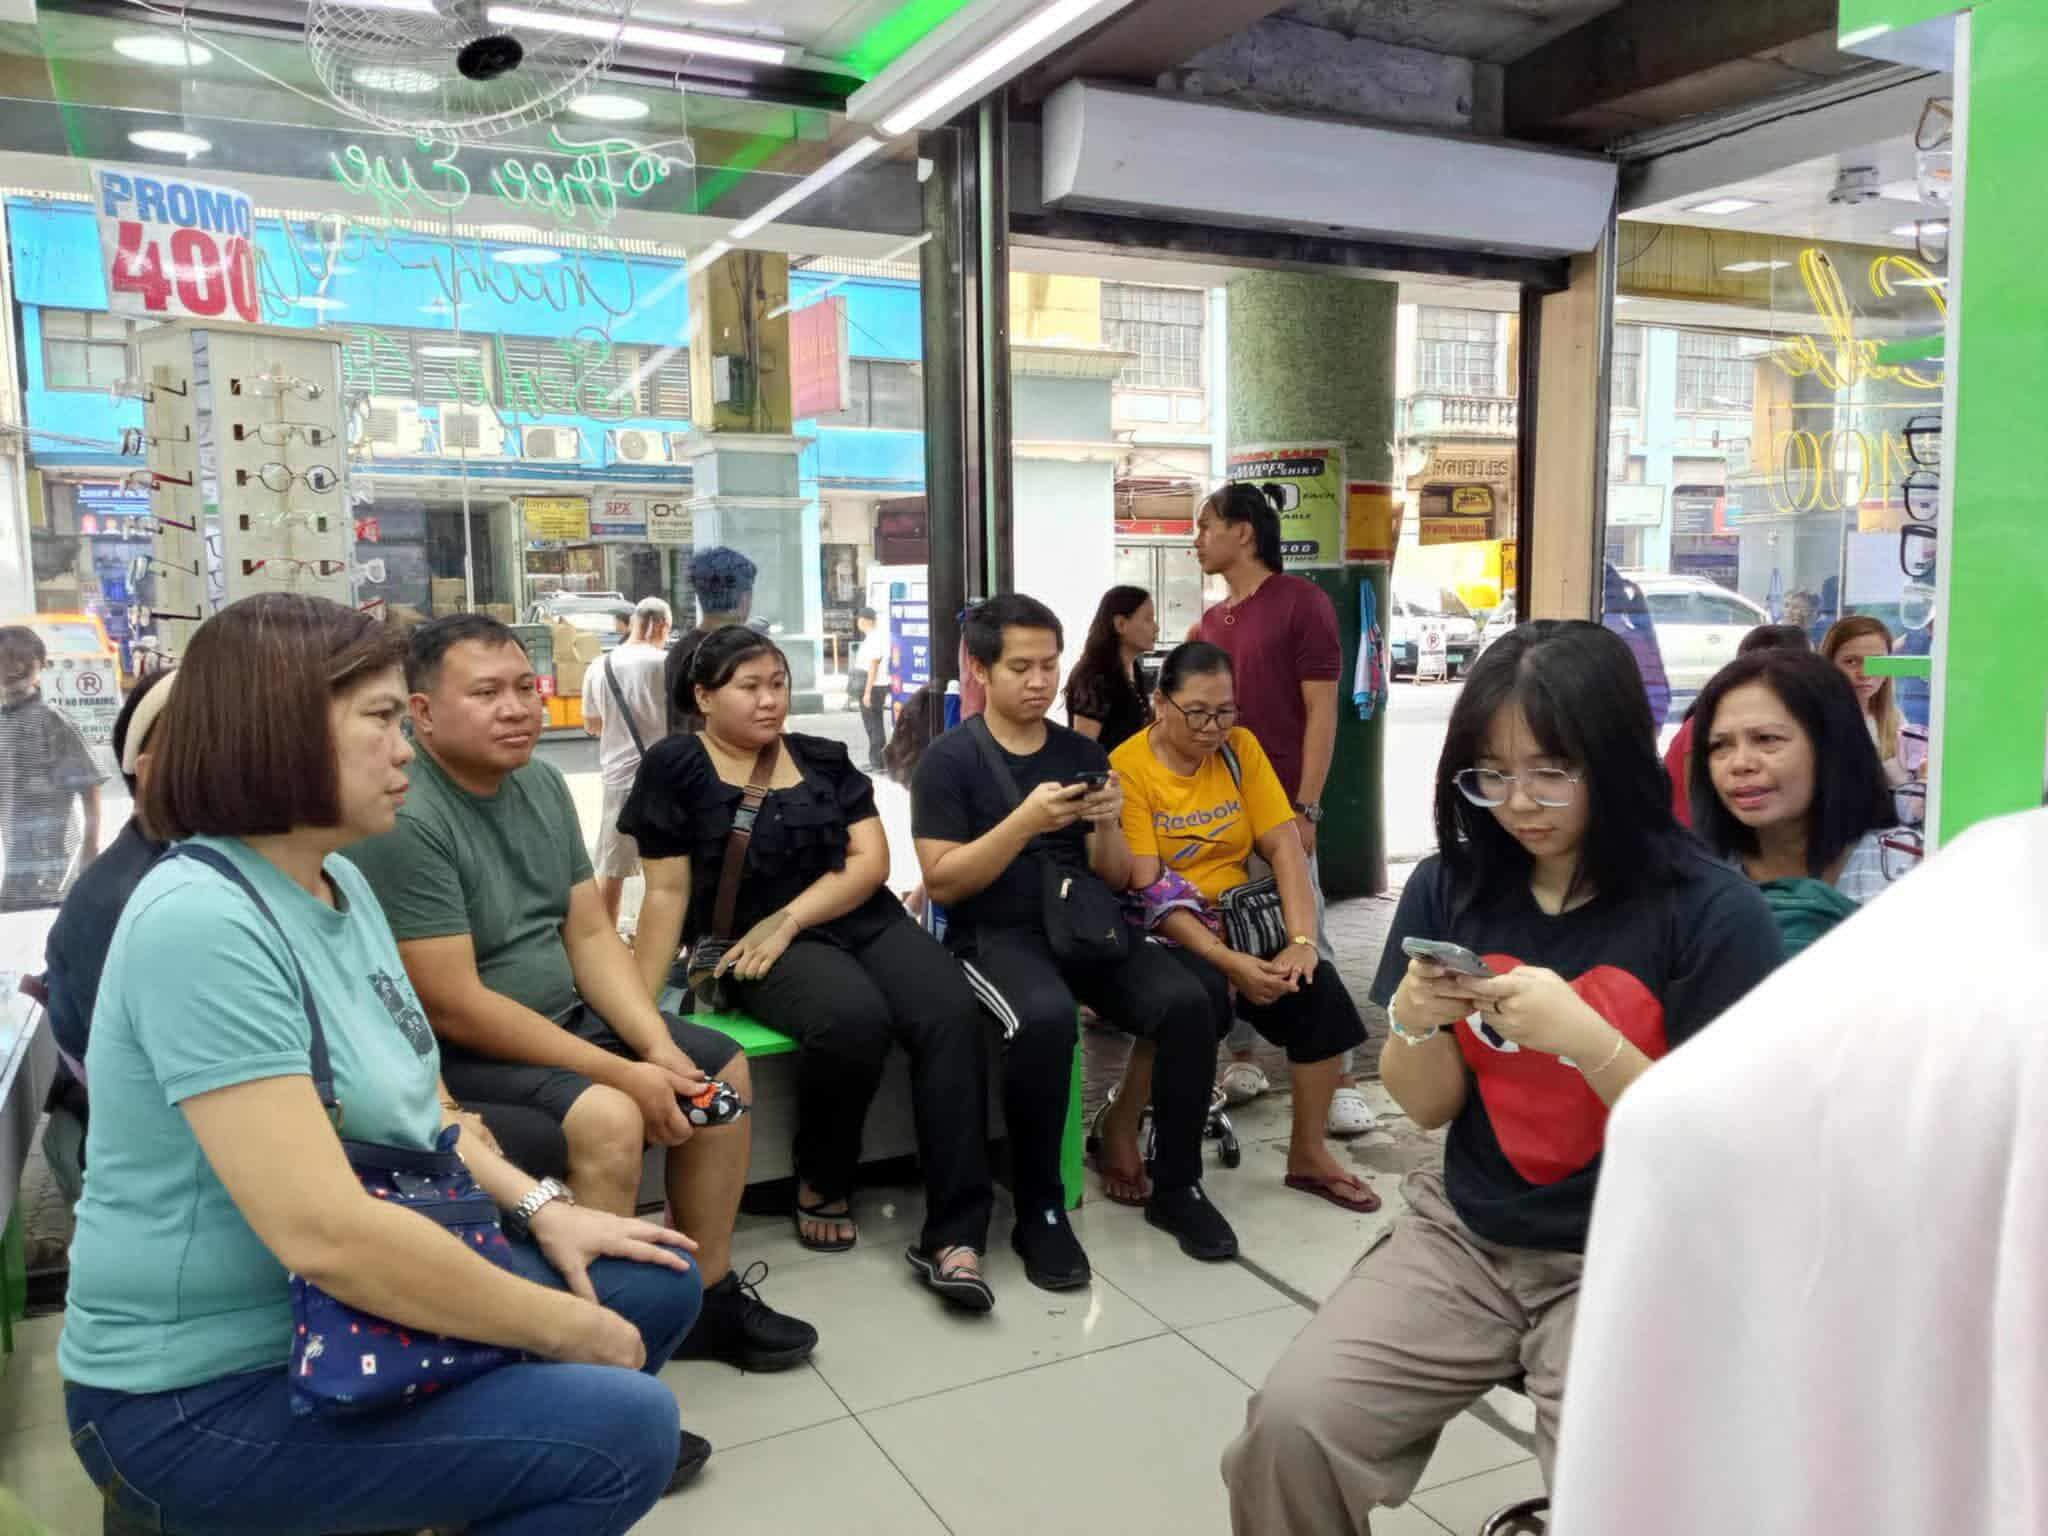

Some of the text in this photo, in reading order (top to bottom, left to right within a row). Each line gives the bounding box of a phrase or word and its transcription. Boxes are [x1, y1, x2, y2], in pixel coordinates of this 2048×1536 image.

[102, 171, 250, 240] PROMO
[112, 221, 258, 322] 400
[1153, 800, 1241, 833] Reebok
